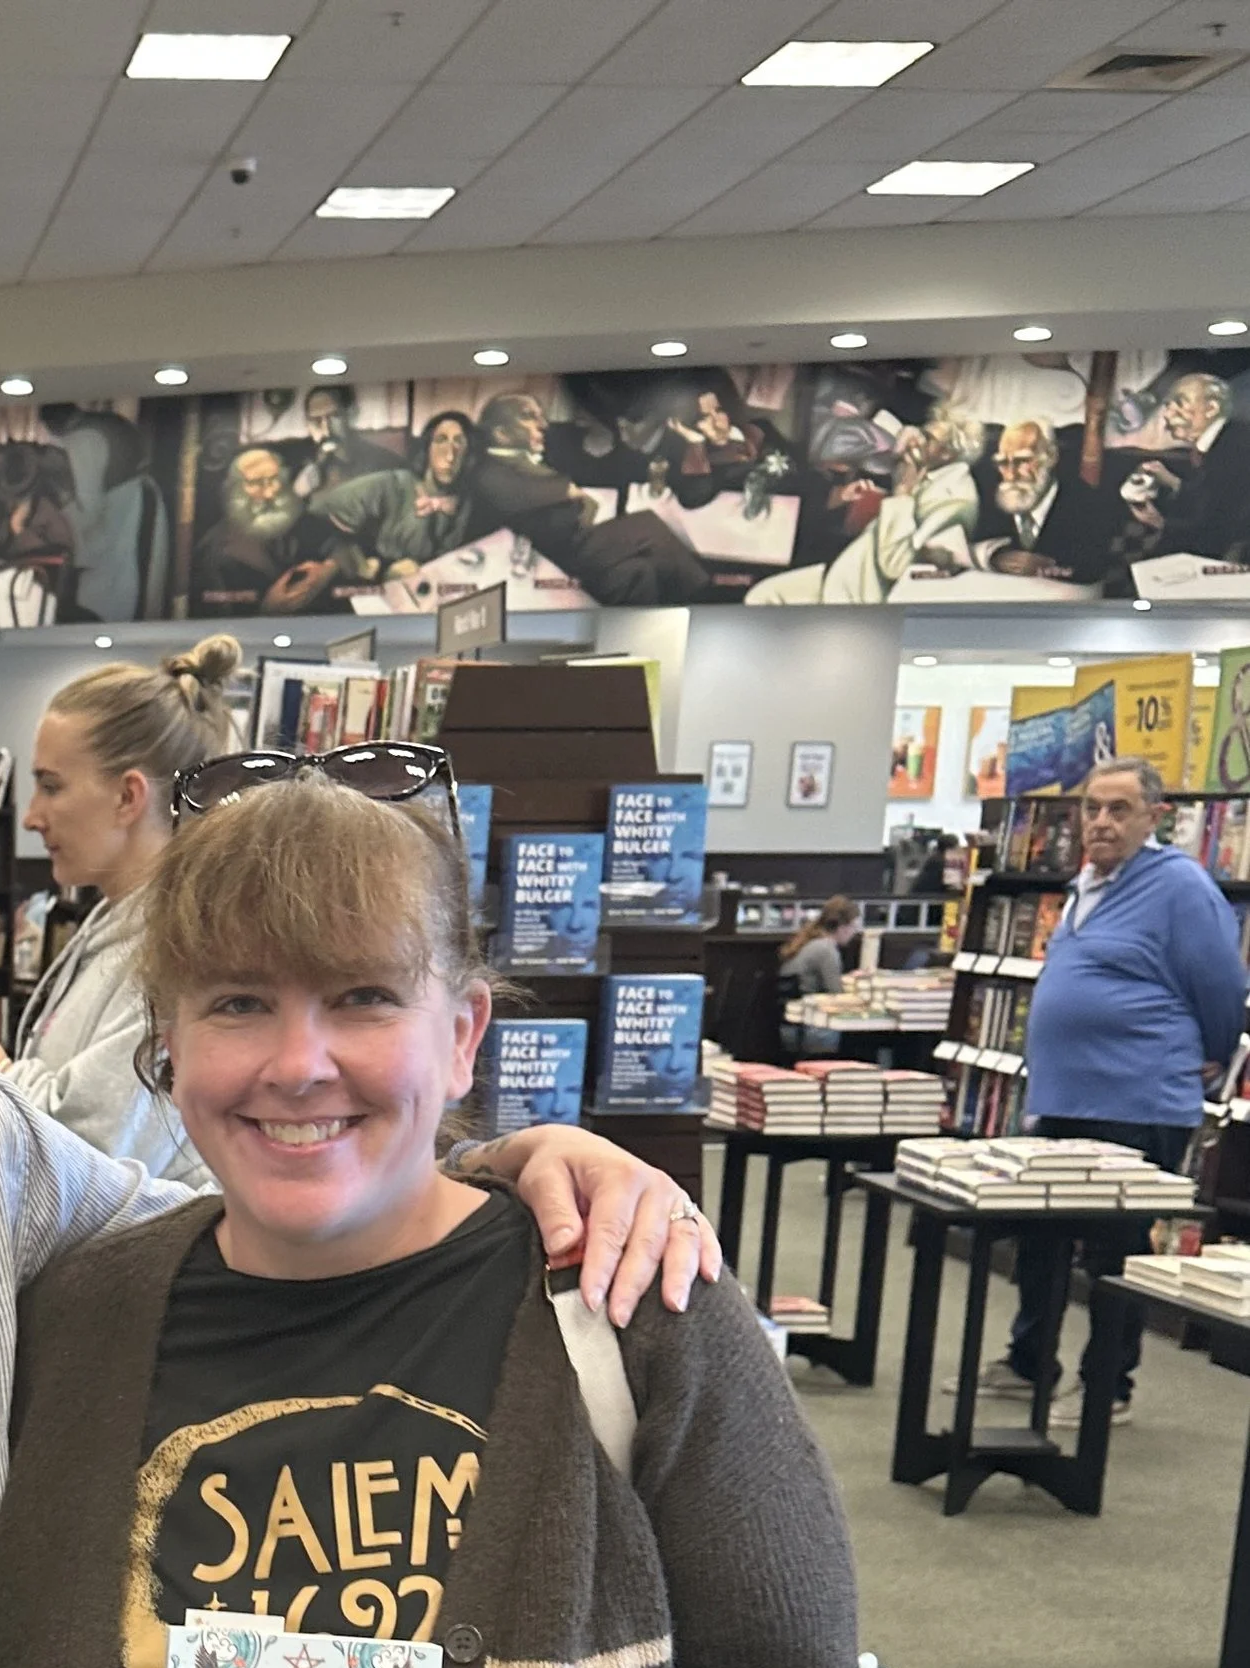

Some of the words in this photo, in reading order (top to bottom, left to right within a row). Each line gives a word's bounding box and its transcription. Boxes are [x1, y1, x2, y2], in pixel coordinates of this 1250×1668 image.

[616, 793, 655, 808] FACE
[657, 796, 673, 807] TO
[615, 809, 653, 823] FACE
[655, 812, 687, 822] WITH
[614, 825, 675, 838] WHITEY
[518, 843, 555, 857] FACE
[559, 846, 574, 857] TO
[613, 840, 671, 853] BULGER
[517, 859, 554, 872] FACE
[557, 861, 588, 872] WITH
[515, 874, 576, 887] WHITEY
[515, 889, 572, 903] BULGER
[617, 986, 655, 1000] FACE
[658, 989, 674, 999] TO
[616, 1001, 654, 1015] FACE
[657, 1004, 688, 1014] WITH
[615, 1016, 676, 1029] WHITEY
[502, 1031, 538, 1044] FACE
[541, 1033, 557, 1044] TO
[613, 1031, 671, 1045] BULGER
[501, 1046, 536, 1059] FACE
[540, 1048, 570, 1058] WITH
[499, 1061, 559, 1074] WHITEY
[498, 1075, 556, 1089] BULGER
[192, 1452, 480, 1583] SALEM
